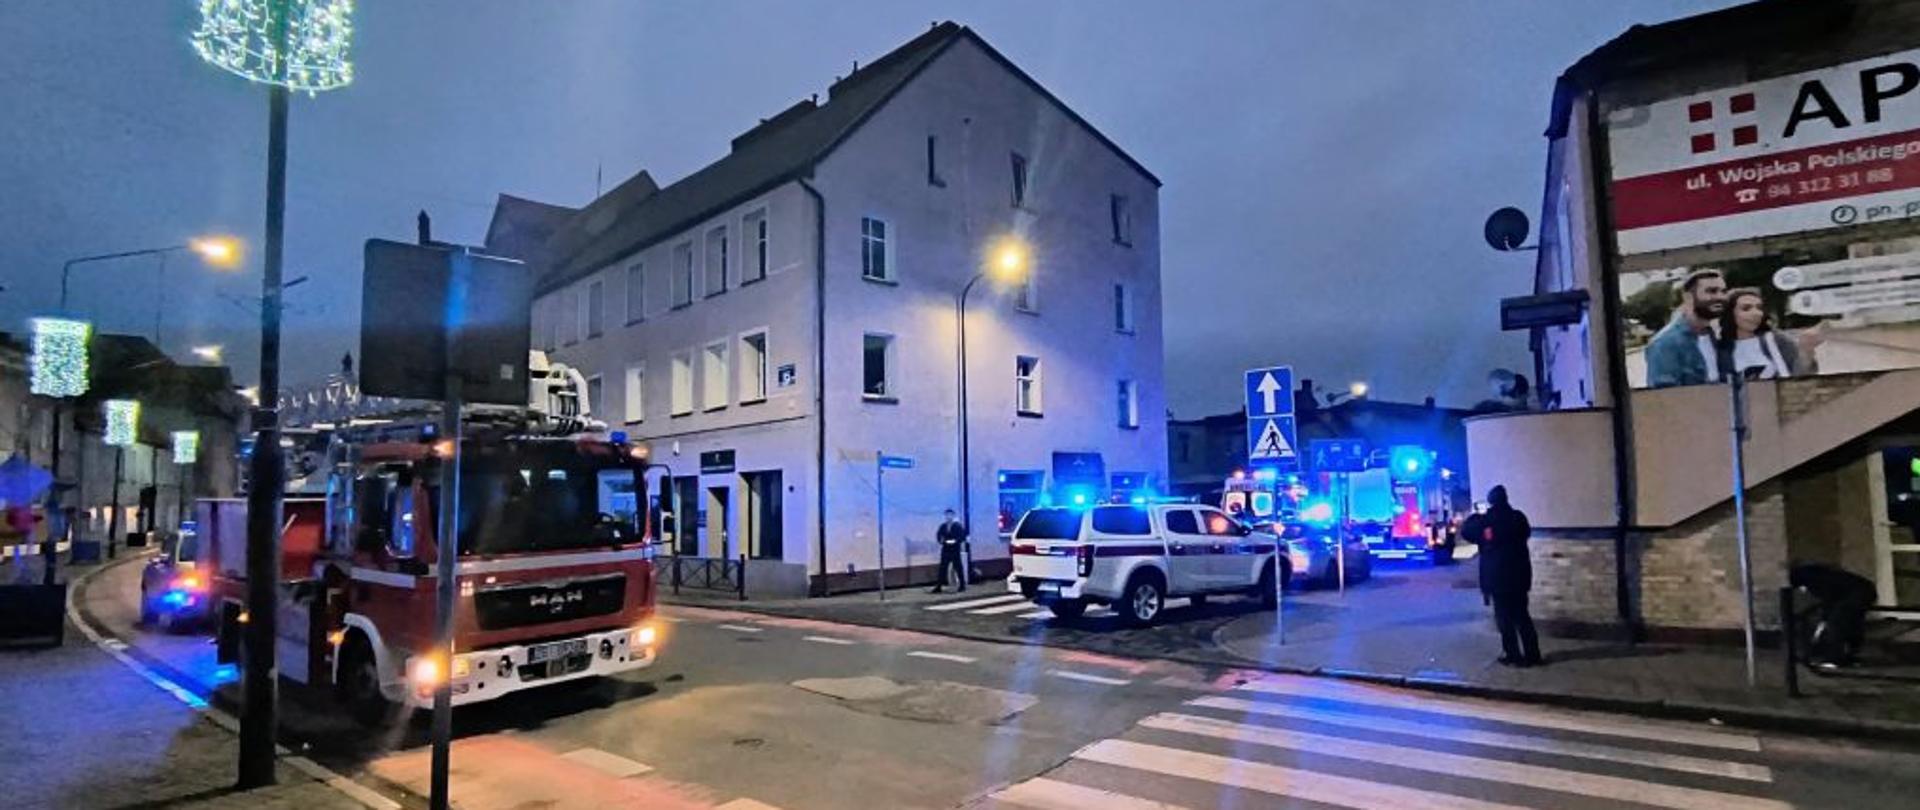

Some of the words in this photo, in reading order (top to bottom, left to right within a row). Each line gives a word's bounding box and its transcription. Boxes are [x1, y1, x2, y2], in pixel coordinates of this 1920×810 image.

[1783, 62, 1920, 138] AP
[1686, 173, 1712, 190] ul.
[1718, 160, 1800, 184] Wojska
[1807, 141, 1920, 170] Polskiego
[1798, 176, 1831, 194] 312
[1838, 171, 1859, 188] 31
[530, 590, 583, 606] MAN
